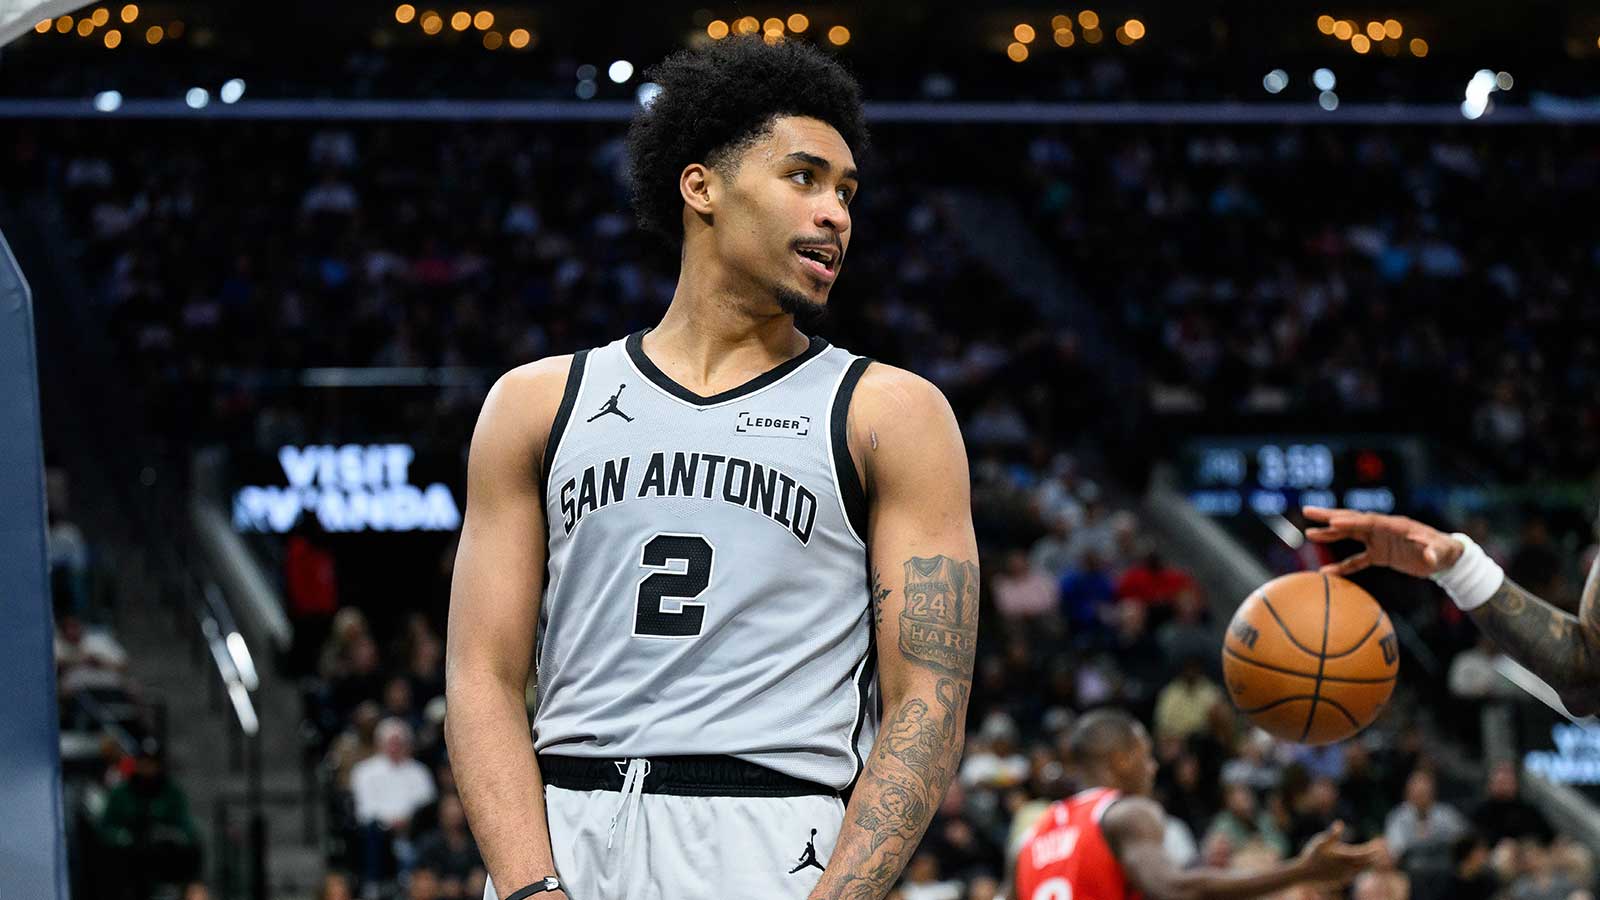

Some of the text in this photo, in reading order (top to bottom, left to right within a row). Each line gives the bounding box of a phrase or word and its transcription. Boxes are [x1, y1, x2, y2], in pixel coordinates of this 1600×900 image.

[745, 416, 801, 430] LEDGER
[278, 443, 415, 487] VISIT
[559, 451, 818, 548] SAN ANTONIO
[631, 532, 716, 639] 2
[911, 592, 947, 618] 24
